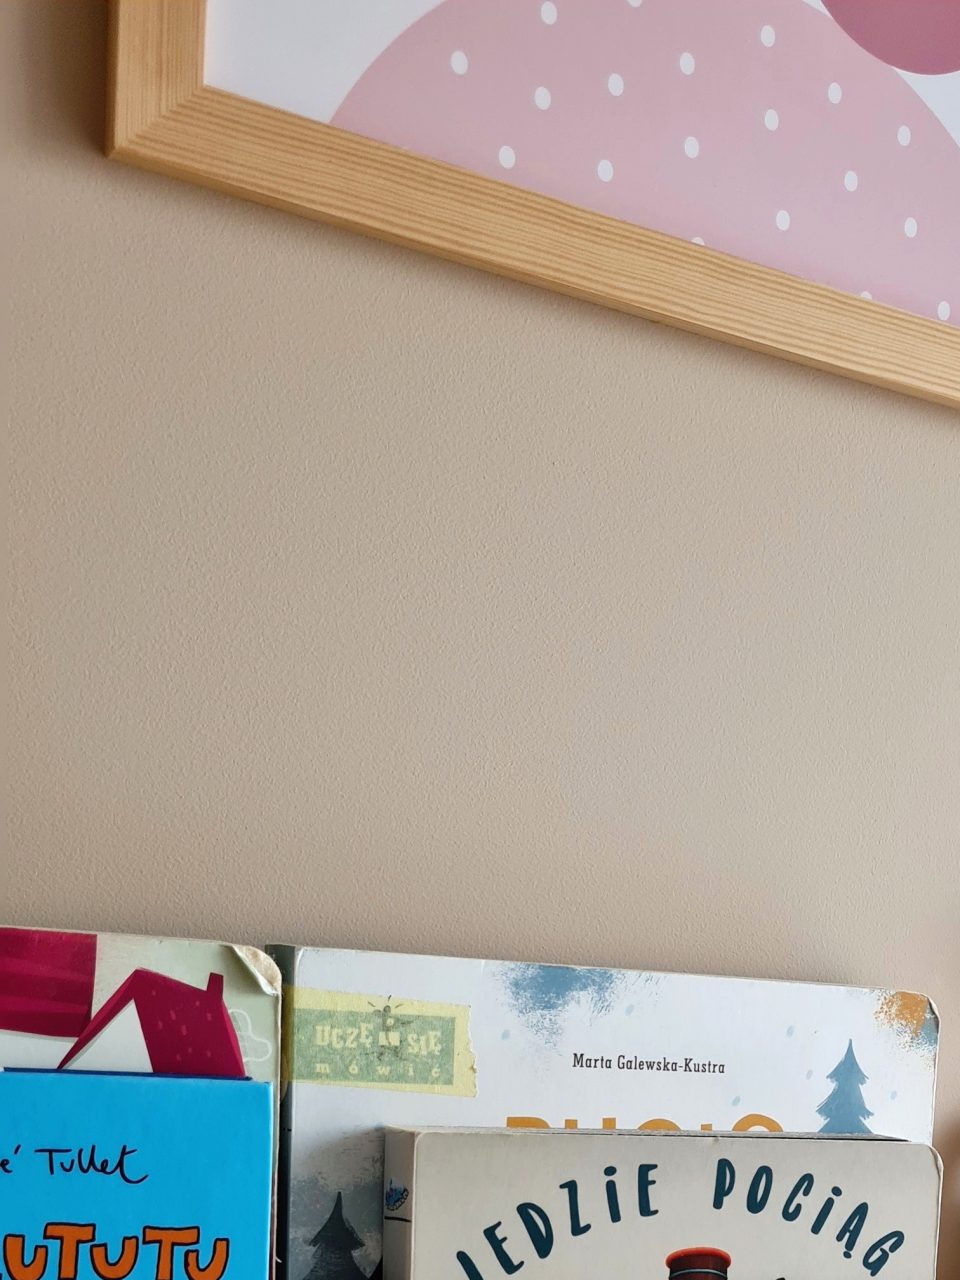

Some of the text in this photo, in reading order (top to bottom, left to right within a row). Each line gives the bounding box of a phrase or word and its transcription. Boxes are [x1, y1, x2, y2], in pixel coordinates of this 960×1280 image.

[572, 1053, 726, 1074] Marta Galewska-Kustra
[34, 1144, 149, 1184] Tullet
